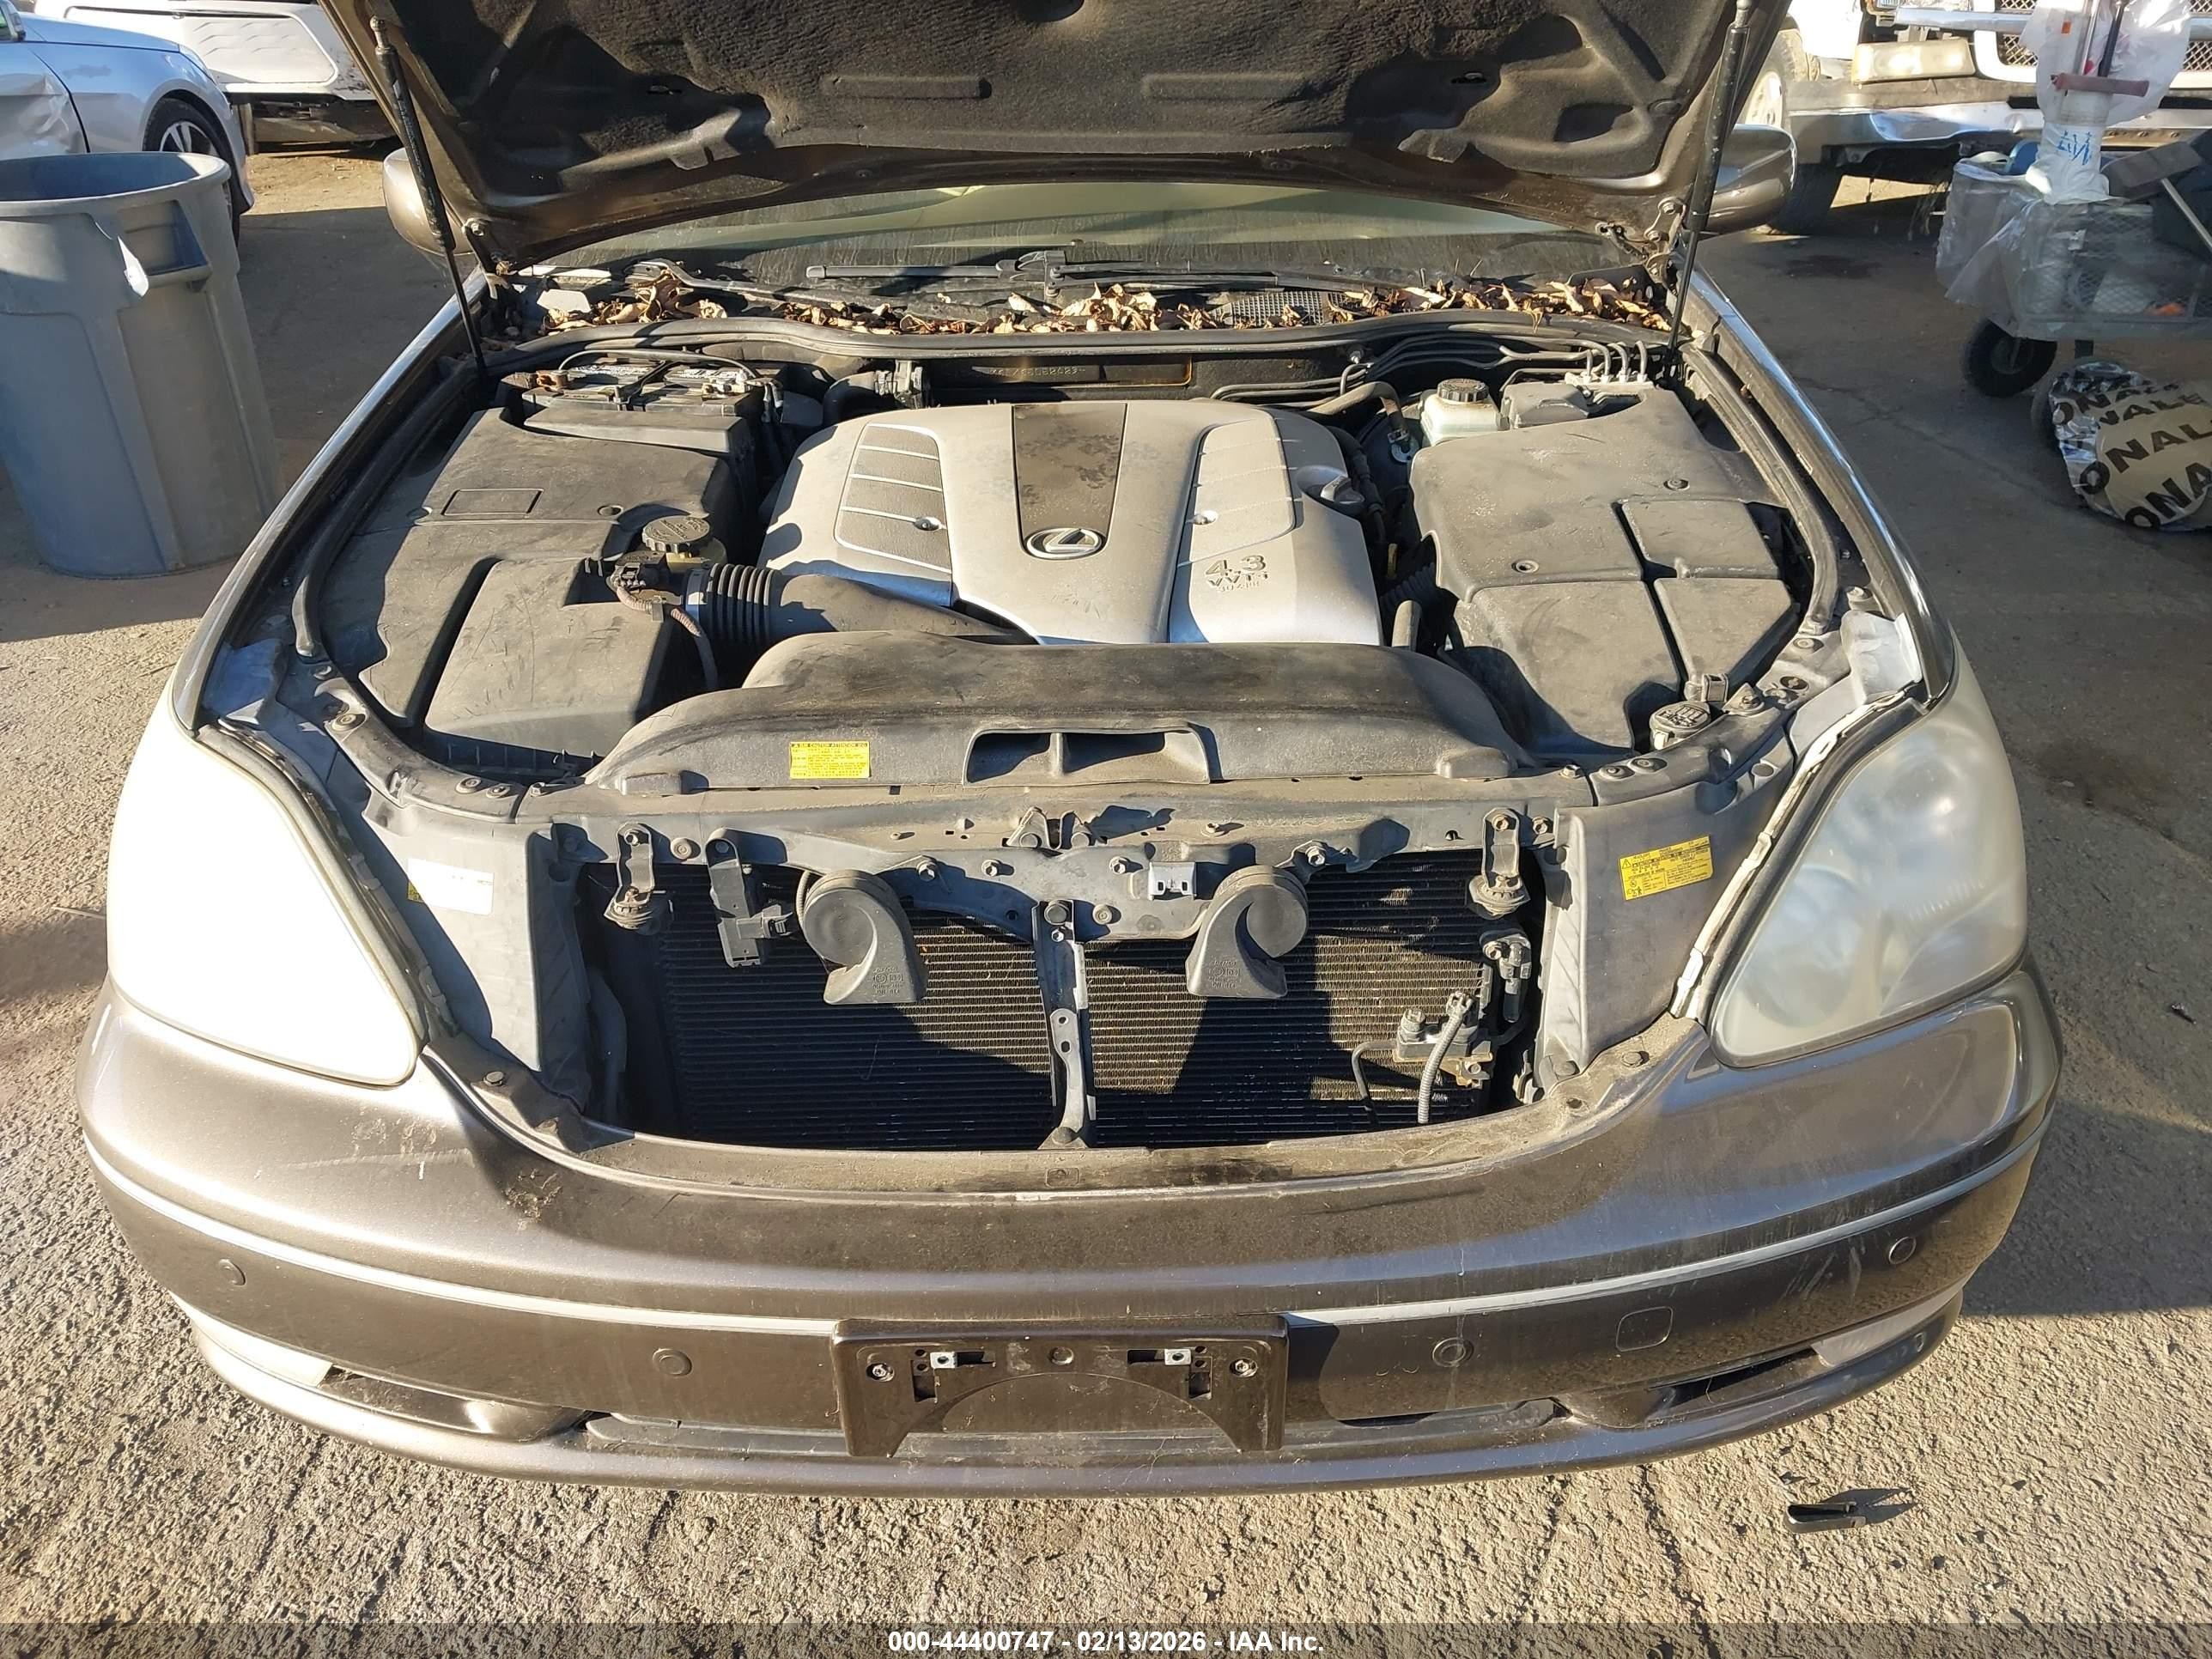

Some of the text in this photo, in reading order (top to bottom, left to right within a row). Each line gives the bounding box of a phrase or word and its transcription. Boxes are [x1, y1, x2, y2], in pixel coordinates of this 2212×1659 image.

[2079, 419, 2212, 495] ONAL
[2124, 462, 2212, 529] ONA
[1206, 555, 1267, 577] 4.3
